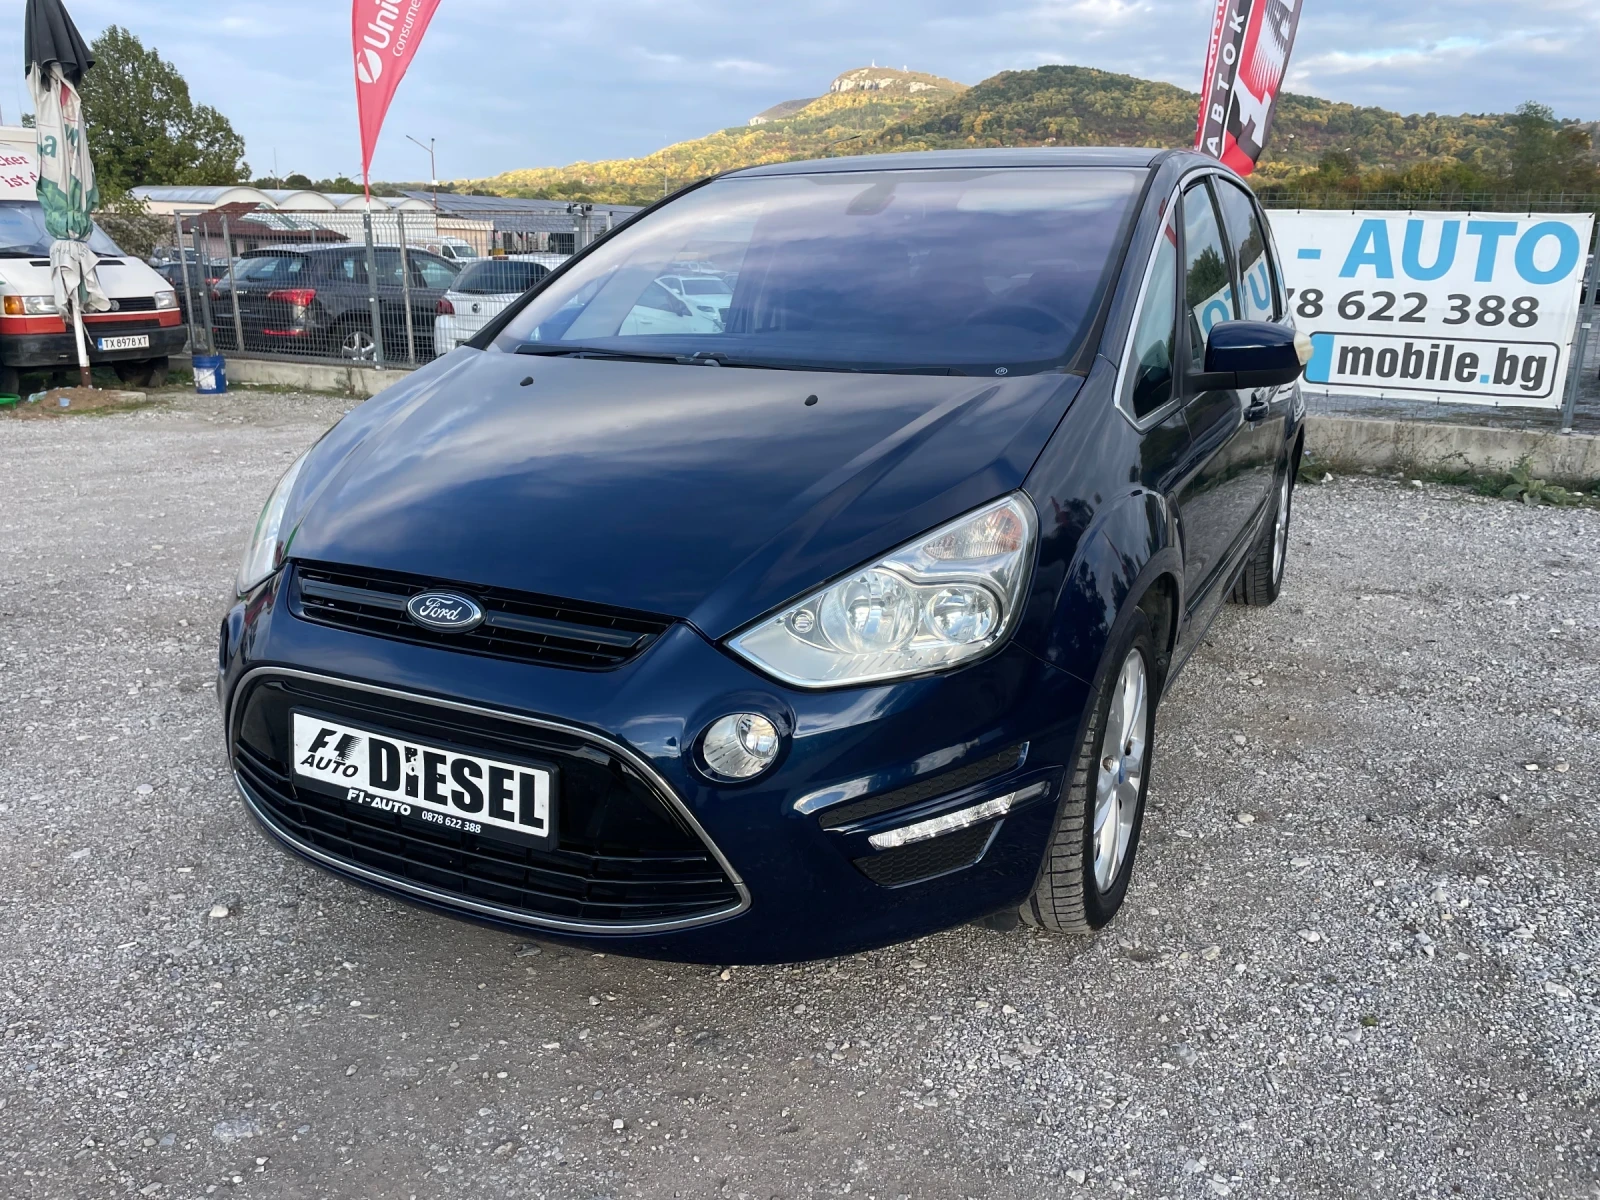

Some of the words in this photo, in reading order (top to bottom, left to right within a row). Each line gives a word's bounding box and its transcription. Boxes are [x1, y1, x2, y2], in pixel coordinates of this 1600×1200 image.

[1339, 219, 1580, 285] AUTO
[1337, 290, 1428, 323] 622
[1442, 293, 1539, 328] 388
[1337, 342, 1547, 391] mobile.bg
[420, 598, 463, 620] Ford
[300, 754, 359, 778] AUTO
[346, 788, 411, 816] F1-AUTO
[421, 810, 443, 824] 0878
[445, 816, 462, 829] 622
[463, 821, 482, 834] 388
